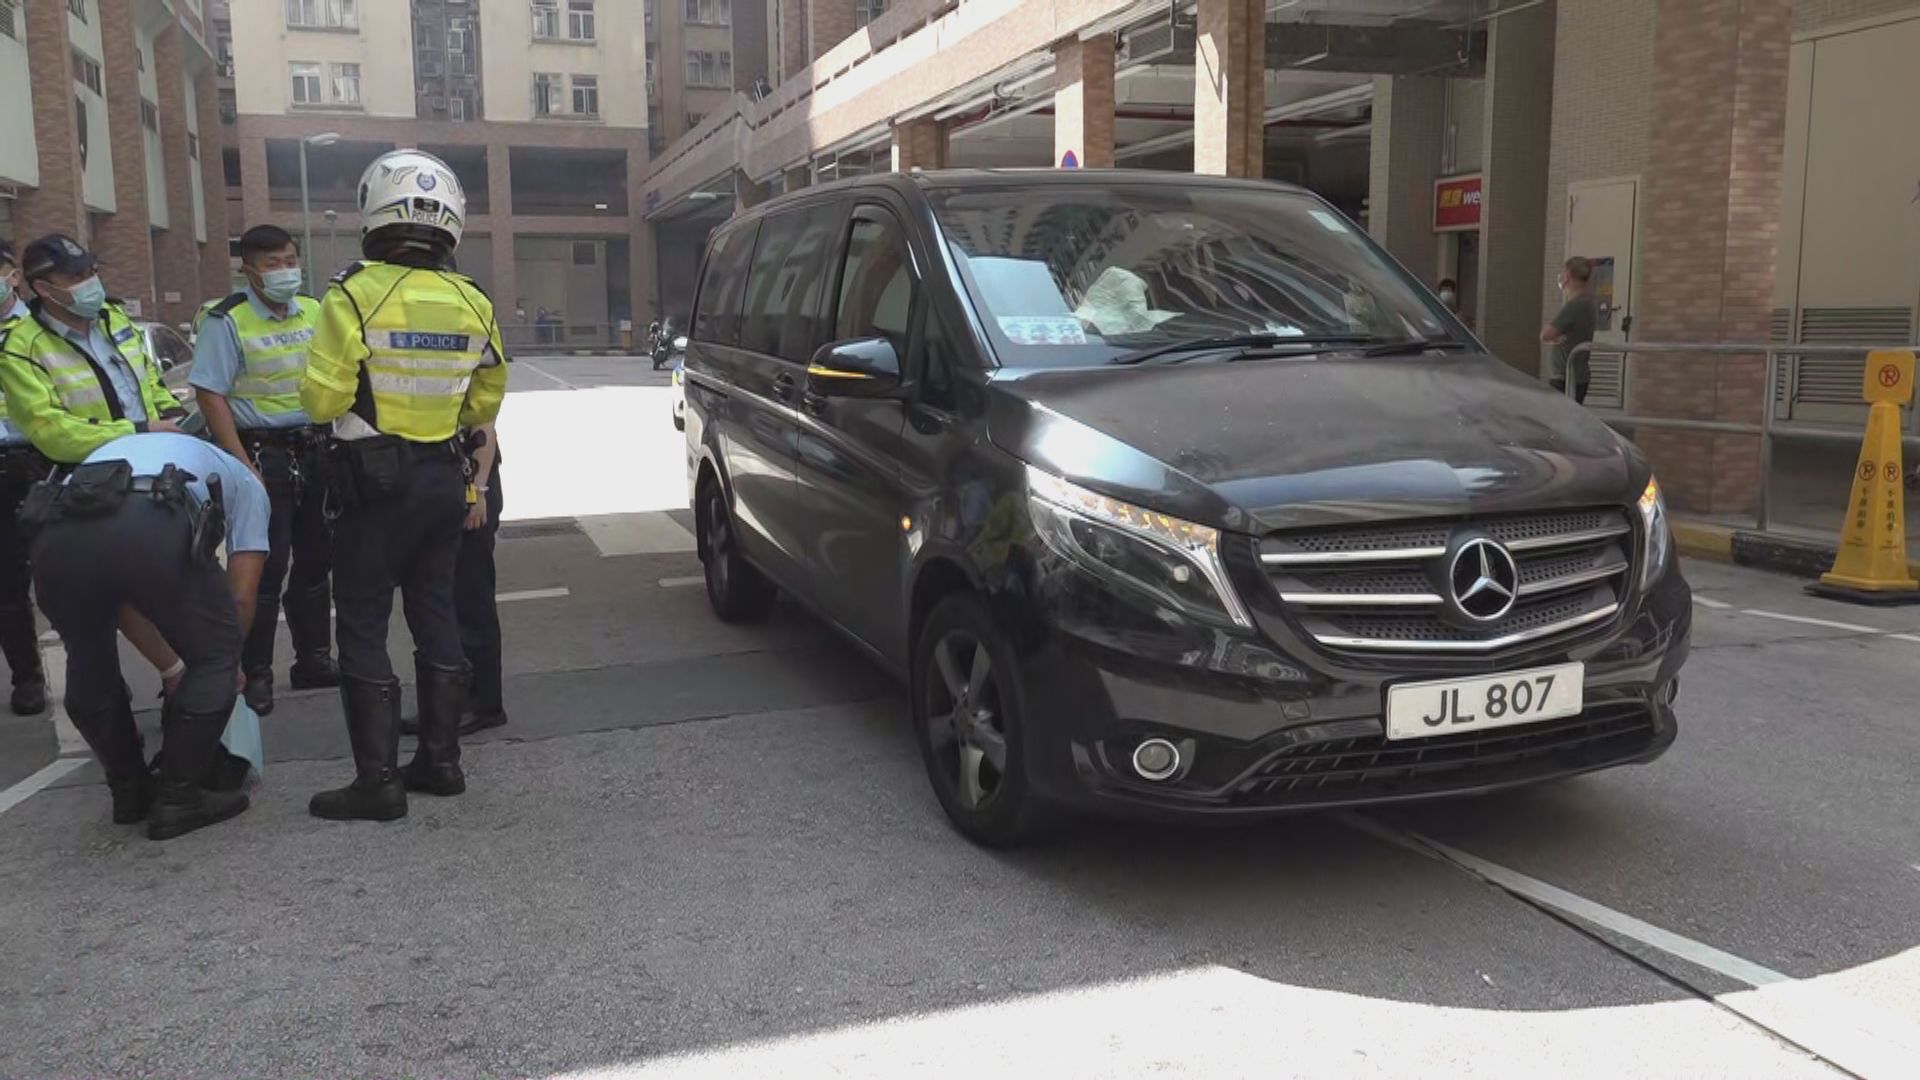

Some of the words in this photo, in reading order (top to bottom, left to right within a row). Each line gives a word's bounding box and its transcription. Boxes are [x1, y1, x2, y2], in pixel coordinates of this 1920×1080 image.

[412, 210, 439, 224] POLICE
[272, 330, 308, 345] POLICE
[411, 334, 458, 349] POLICE
[1423, 688, 1475, 727] JL
[1485, 674, 1556, 719] 807
